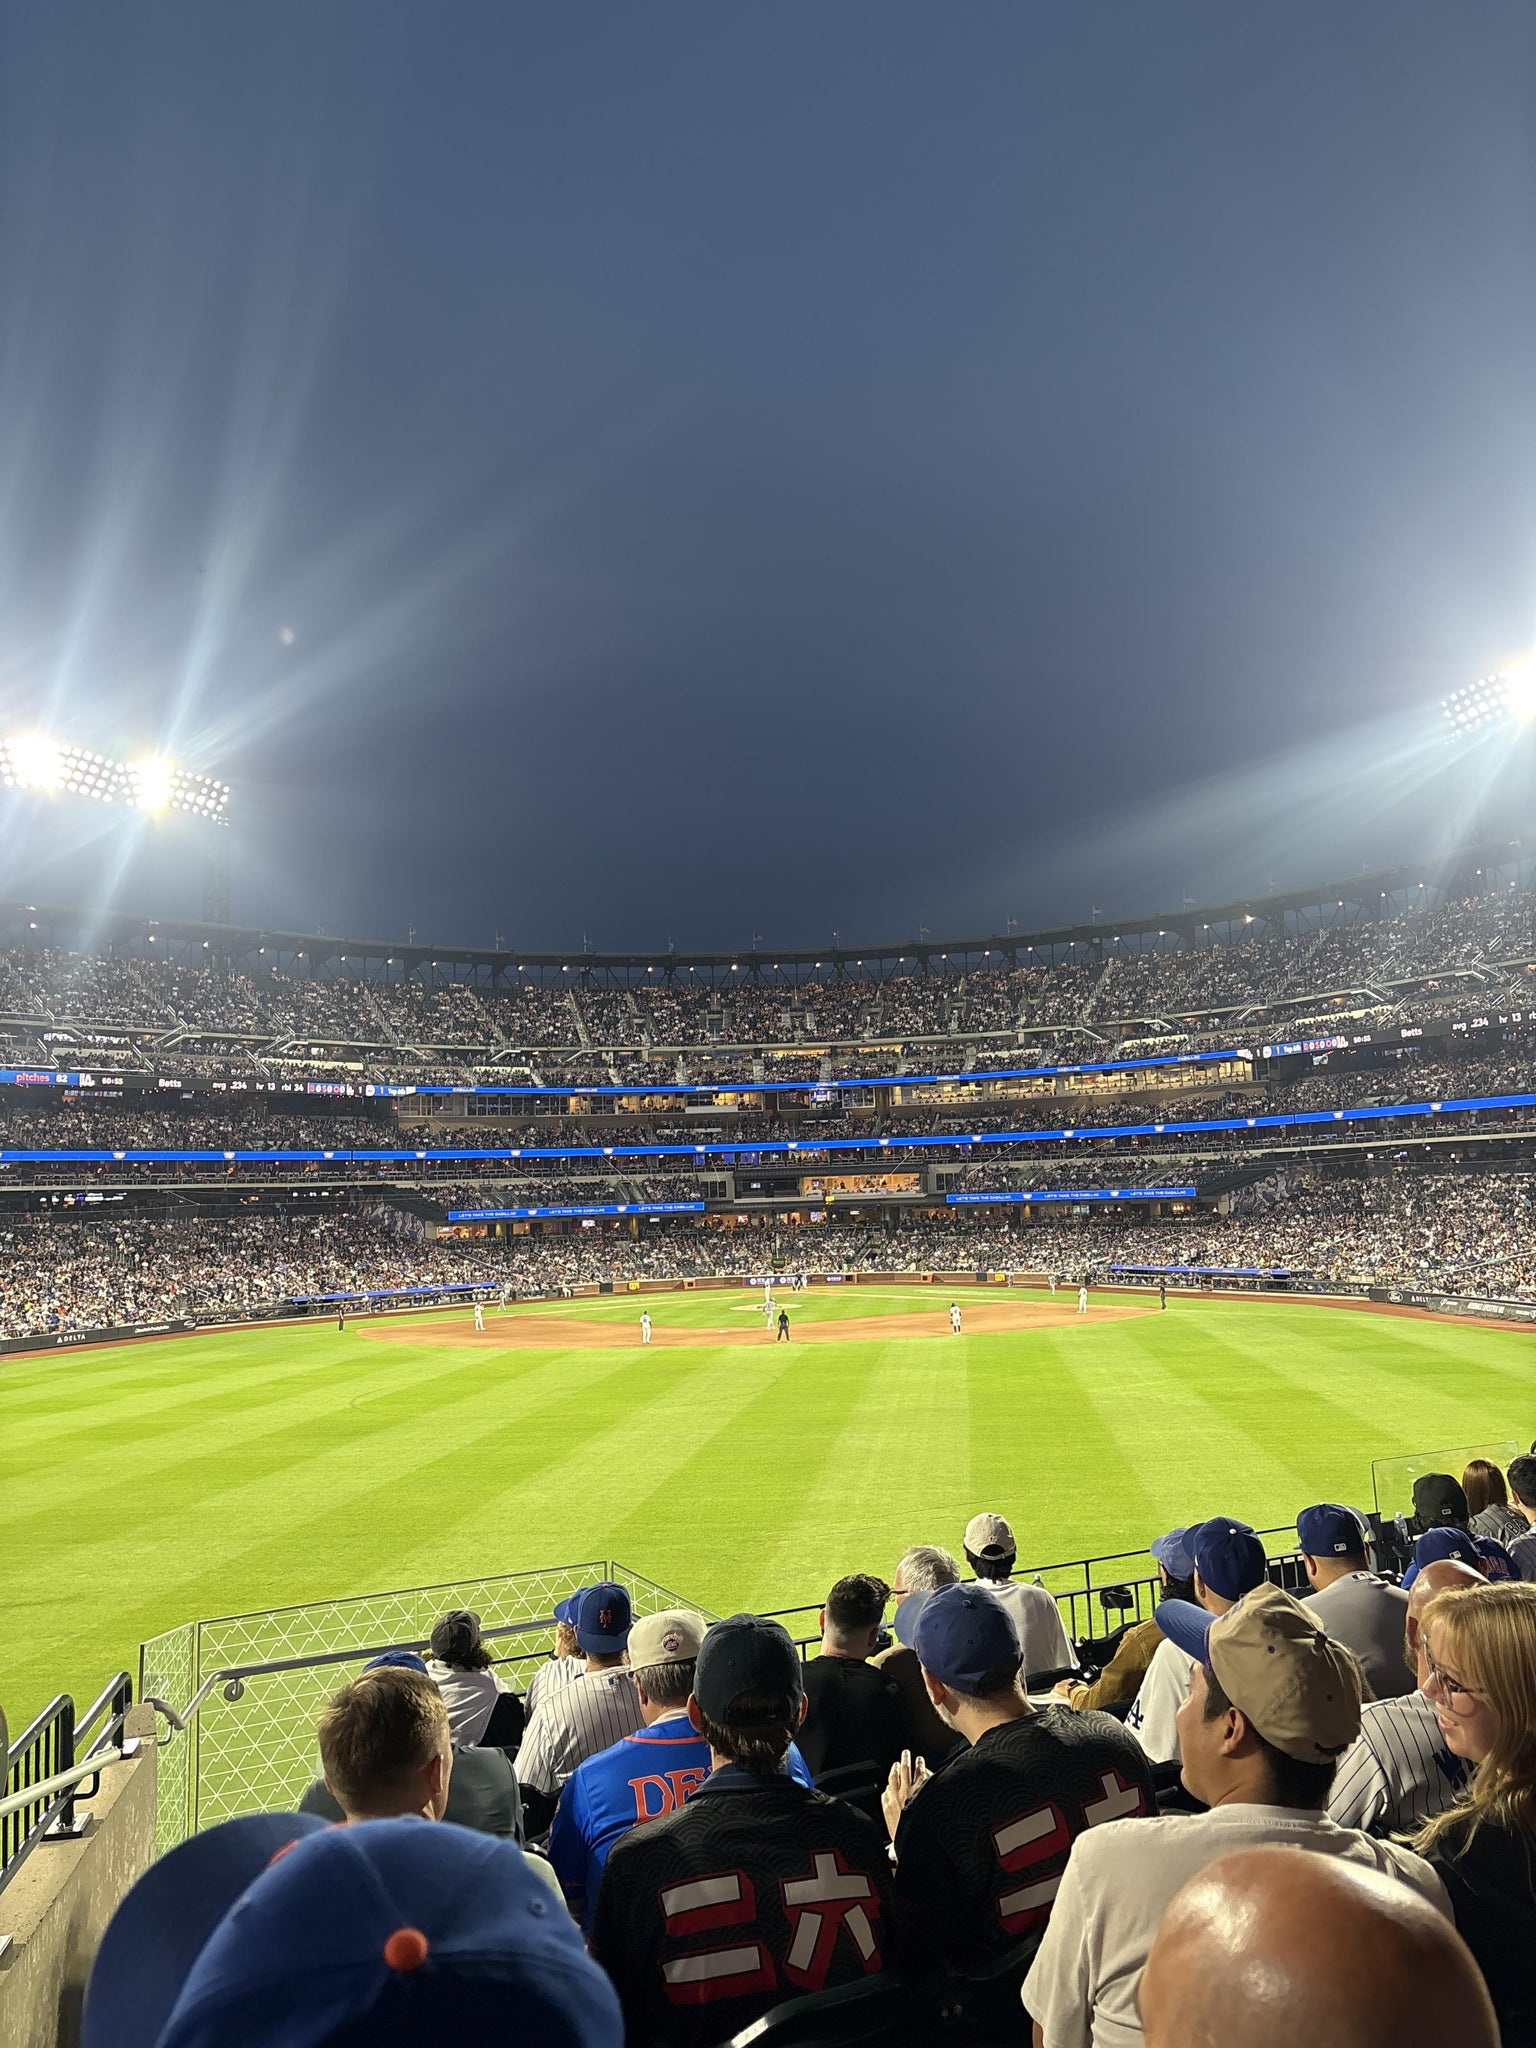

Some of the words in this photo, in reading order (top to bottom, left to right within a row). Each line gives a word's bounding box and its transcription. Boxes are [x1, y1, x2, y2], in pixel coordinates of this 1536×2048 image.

[1452, 1022, 1466, 1031] avg
[1499, 1016, 1508, 1024] hr
[1512, 1013, 1521, 1022] 13
[1401, 1028, 1422, 1038] Betts
[16, 1072, 50, 1082] pitches
[56, 1074, 68, 1082] 82
[159, 1079, 182, 1088] Betts
[213, 1082, 226, 1090] avg
[256, 1082, 264, 1090] hr
[268, 1082, 276, 1090] 13
[281, 1083, 291, 1091] rbi
[64, 1334, 86, 1342] DELTA
[628, 1766, 714, 1827] DE
[658, 1849, 881, 2003] 二六
